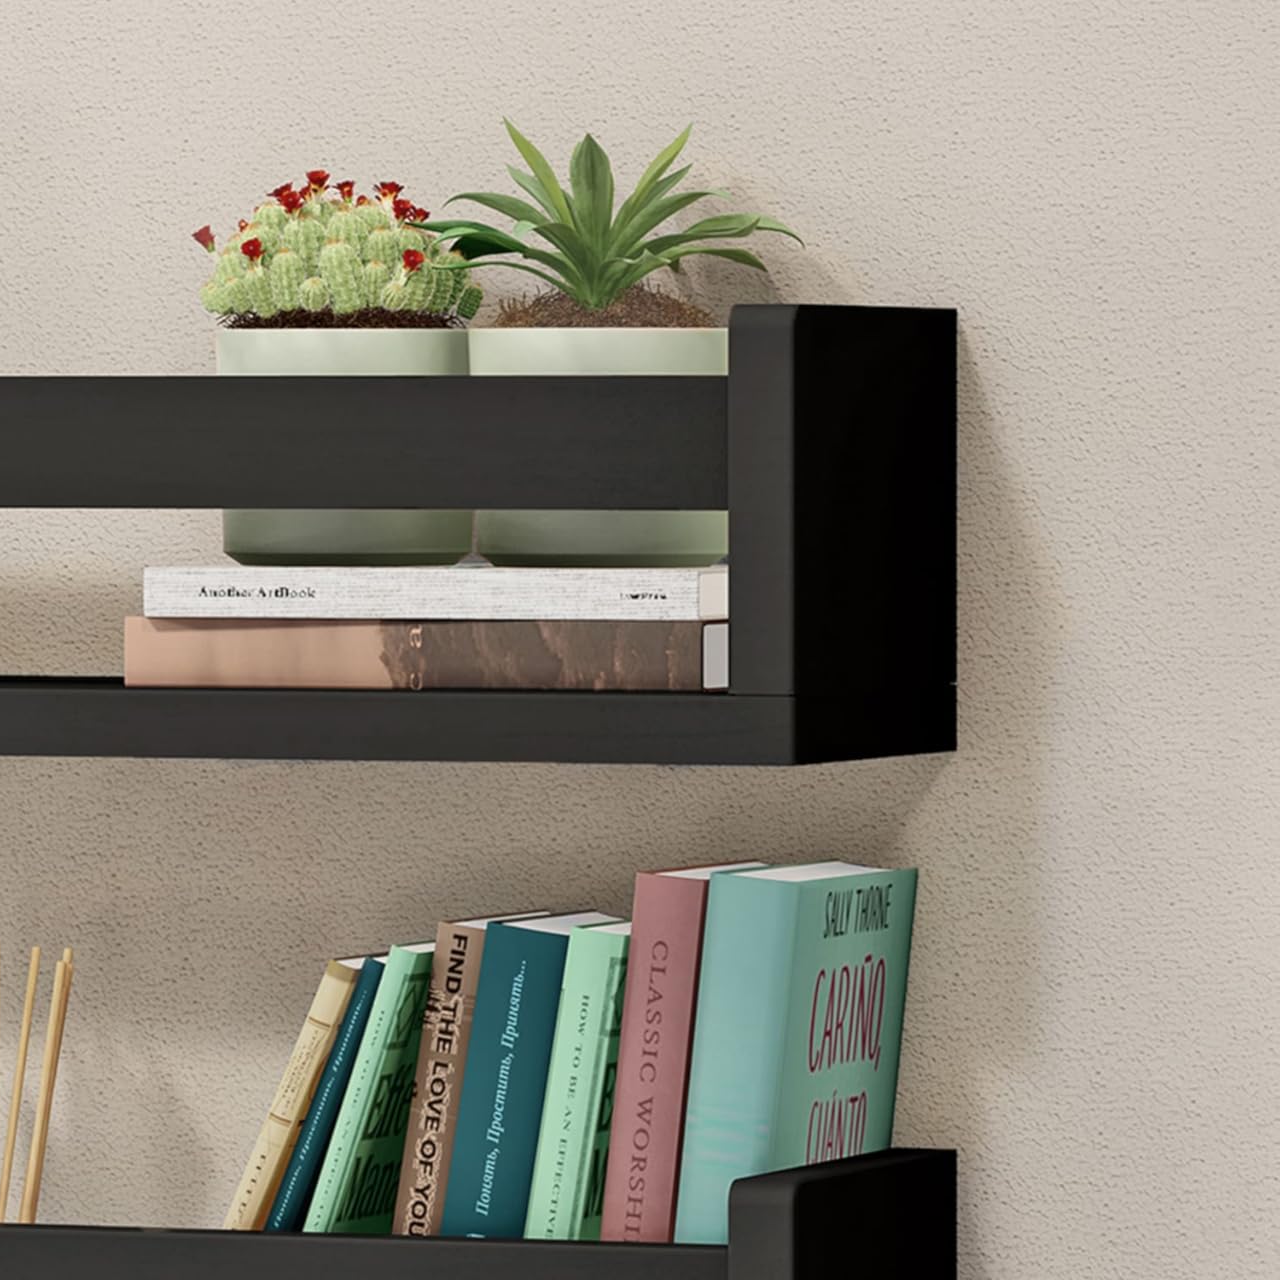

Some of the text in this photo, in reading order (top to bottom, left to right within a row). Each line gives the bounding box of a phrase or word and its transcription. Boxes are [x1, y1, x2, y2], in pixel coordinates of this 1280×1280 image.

[823, 889, 854, 939] SALLY
[445, 933, 469, 994] FIND
[437, 1002, 458, 1053] THE
[808, 953, 886, 1073] CARIÑO,
[424, 1061, 449, 1132] LOVE
[623, 940, 669, 1242] CLASSIC WORSHI
[419, 1140, 436, 1176] OF
